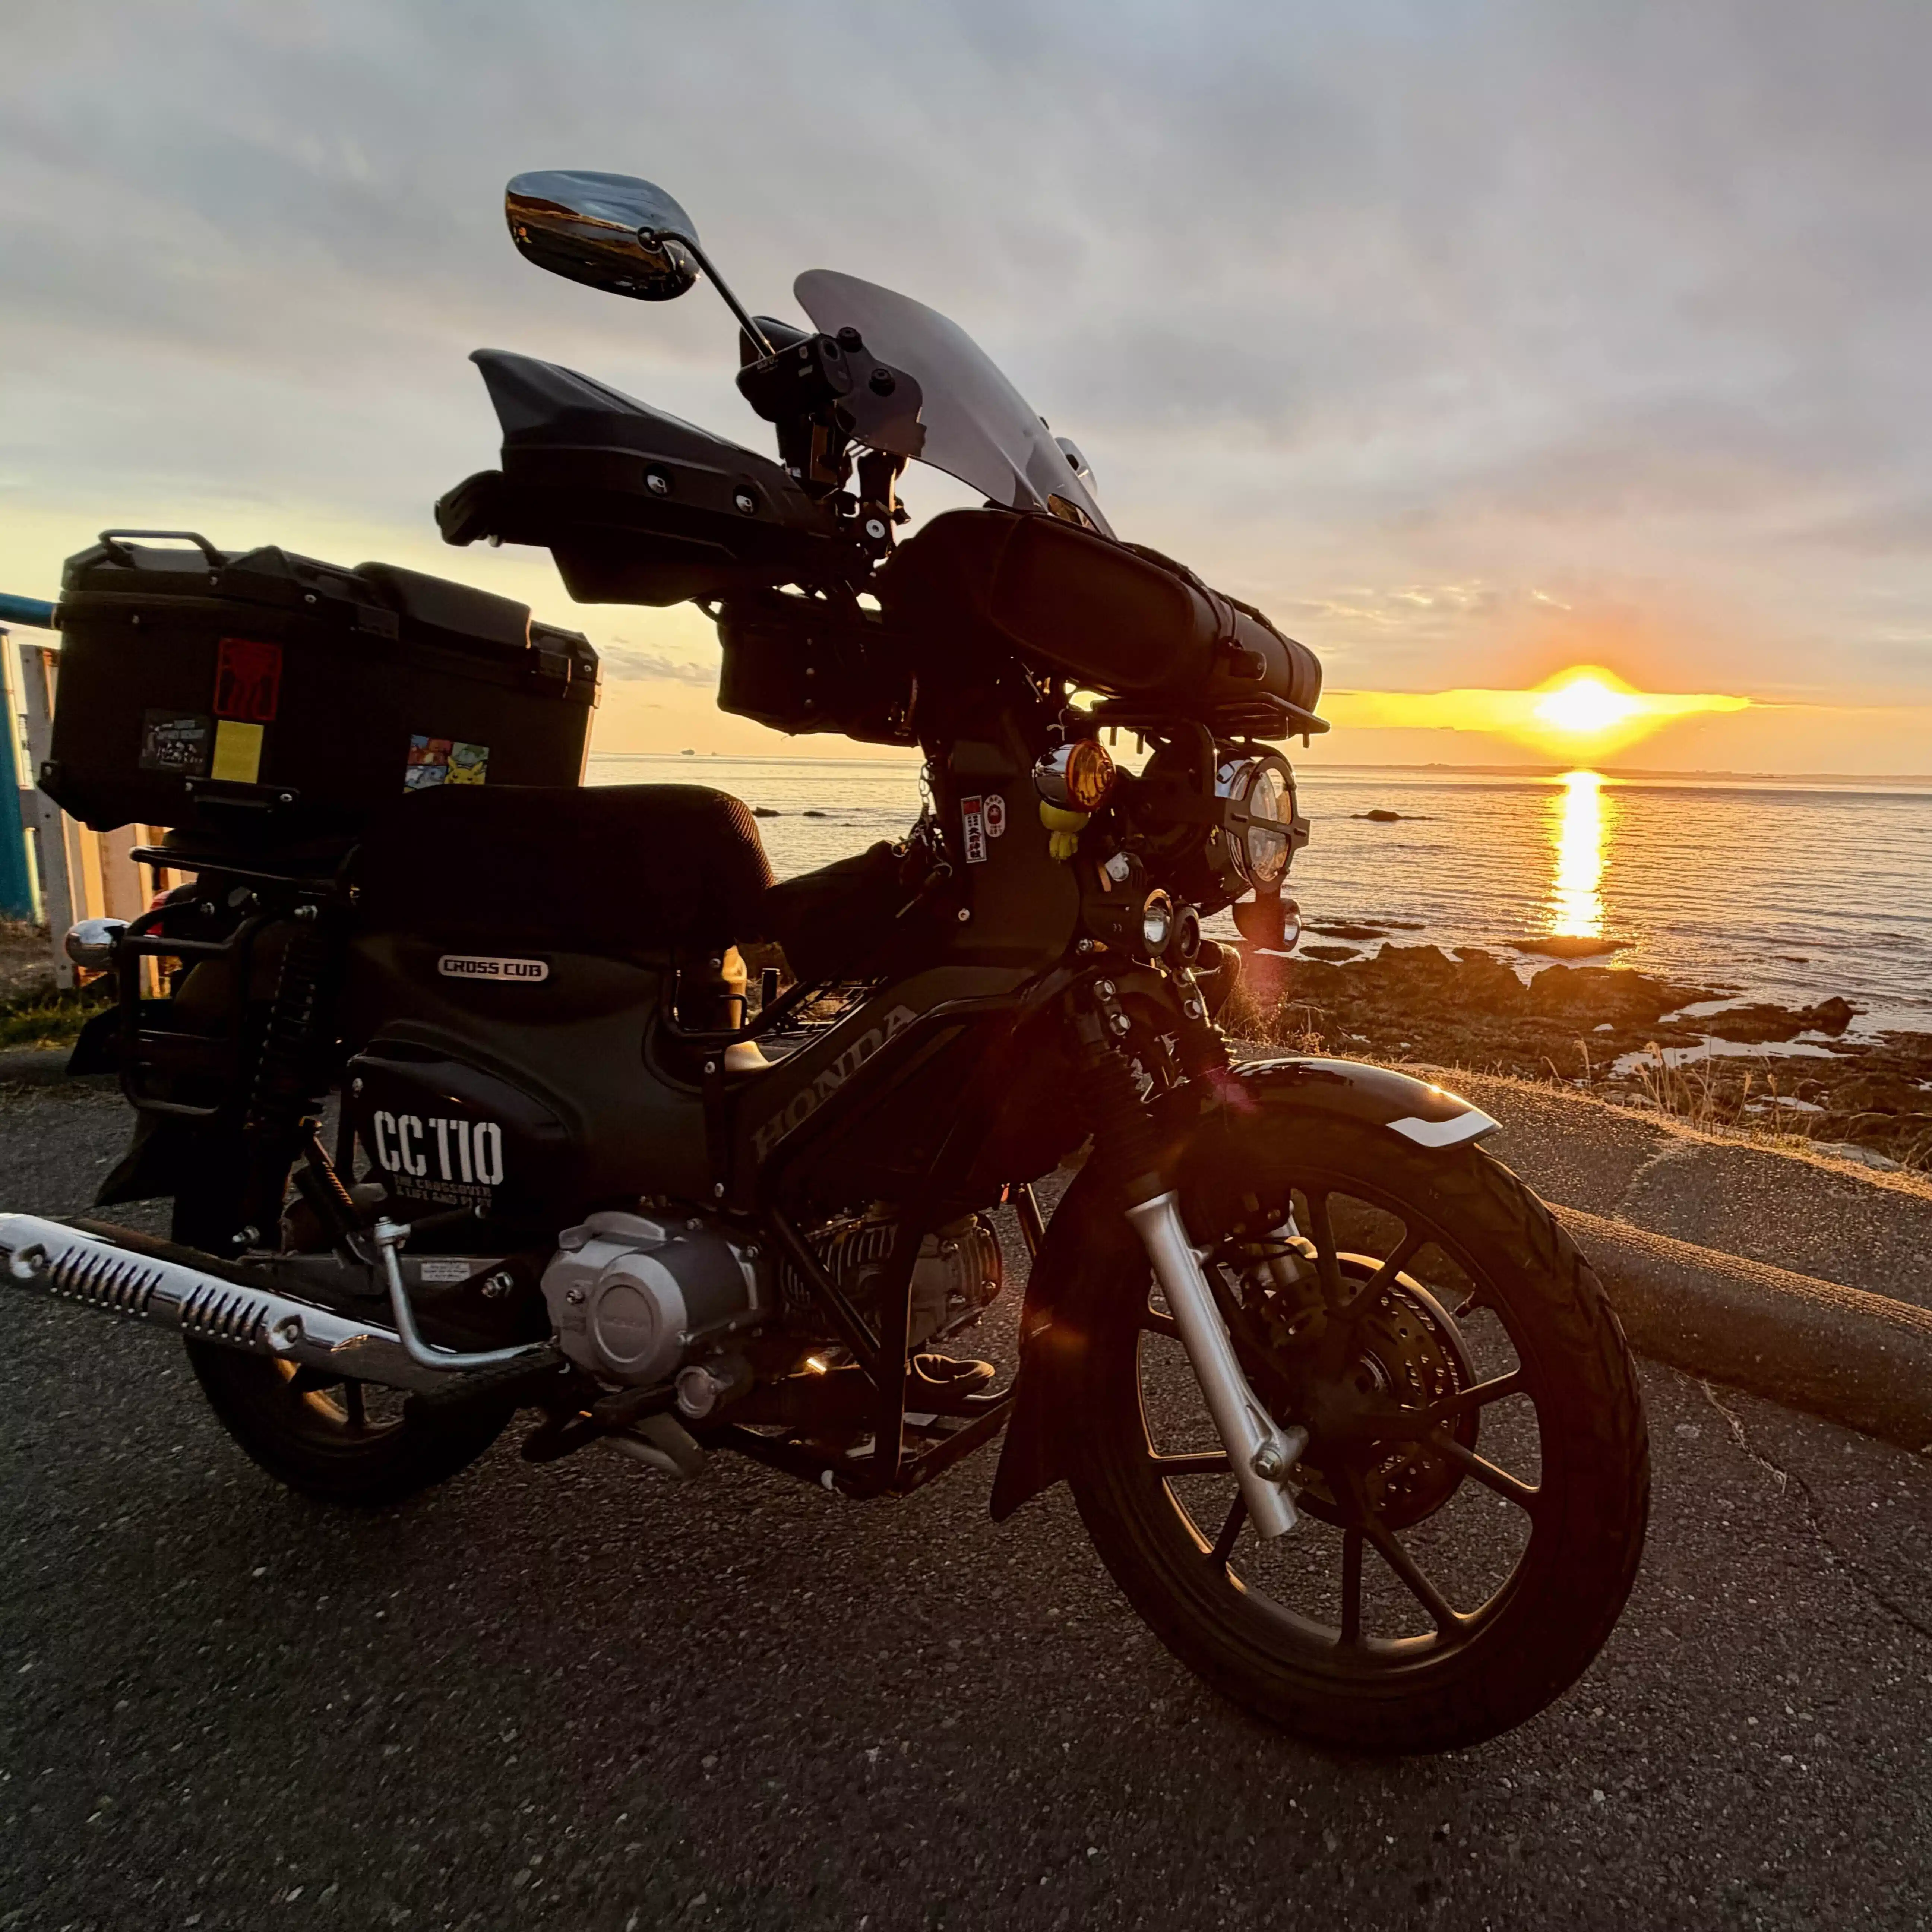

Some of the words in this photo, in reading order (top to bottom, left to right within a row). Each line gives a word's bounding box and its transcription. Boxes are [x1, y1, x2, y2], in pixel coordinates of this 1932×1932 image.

[444, 959, 499, 974] CROSS
[504, 963, 541, 977] CUB
[750, 1005, 918, 1163] HONDA
